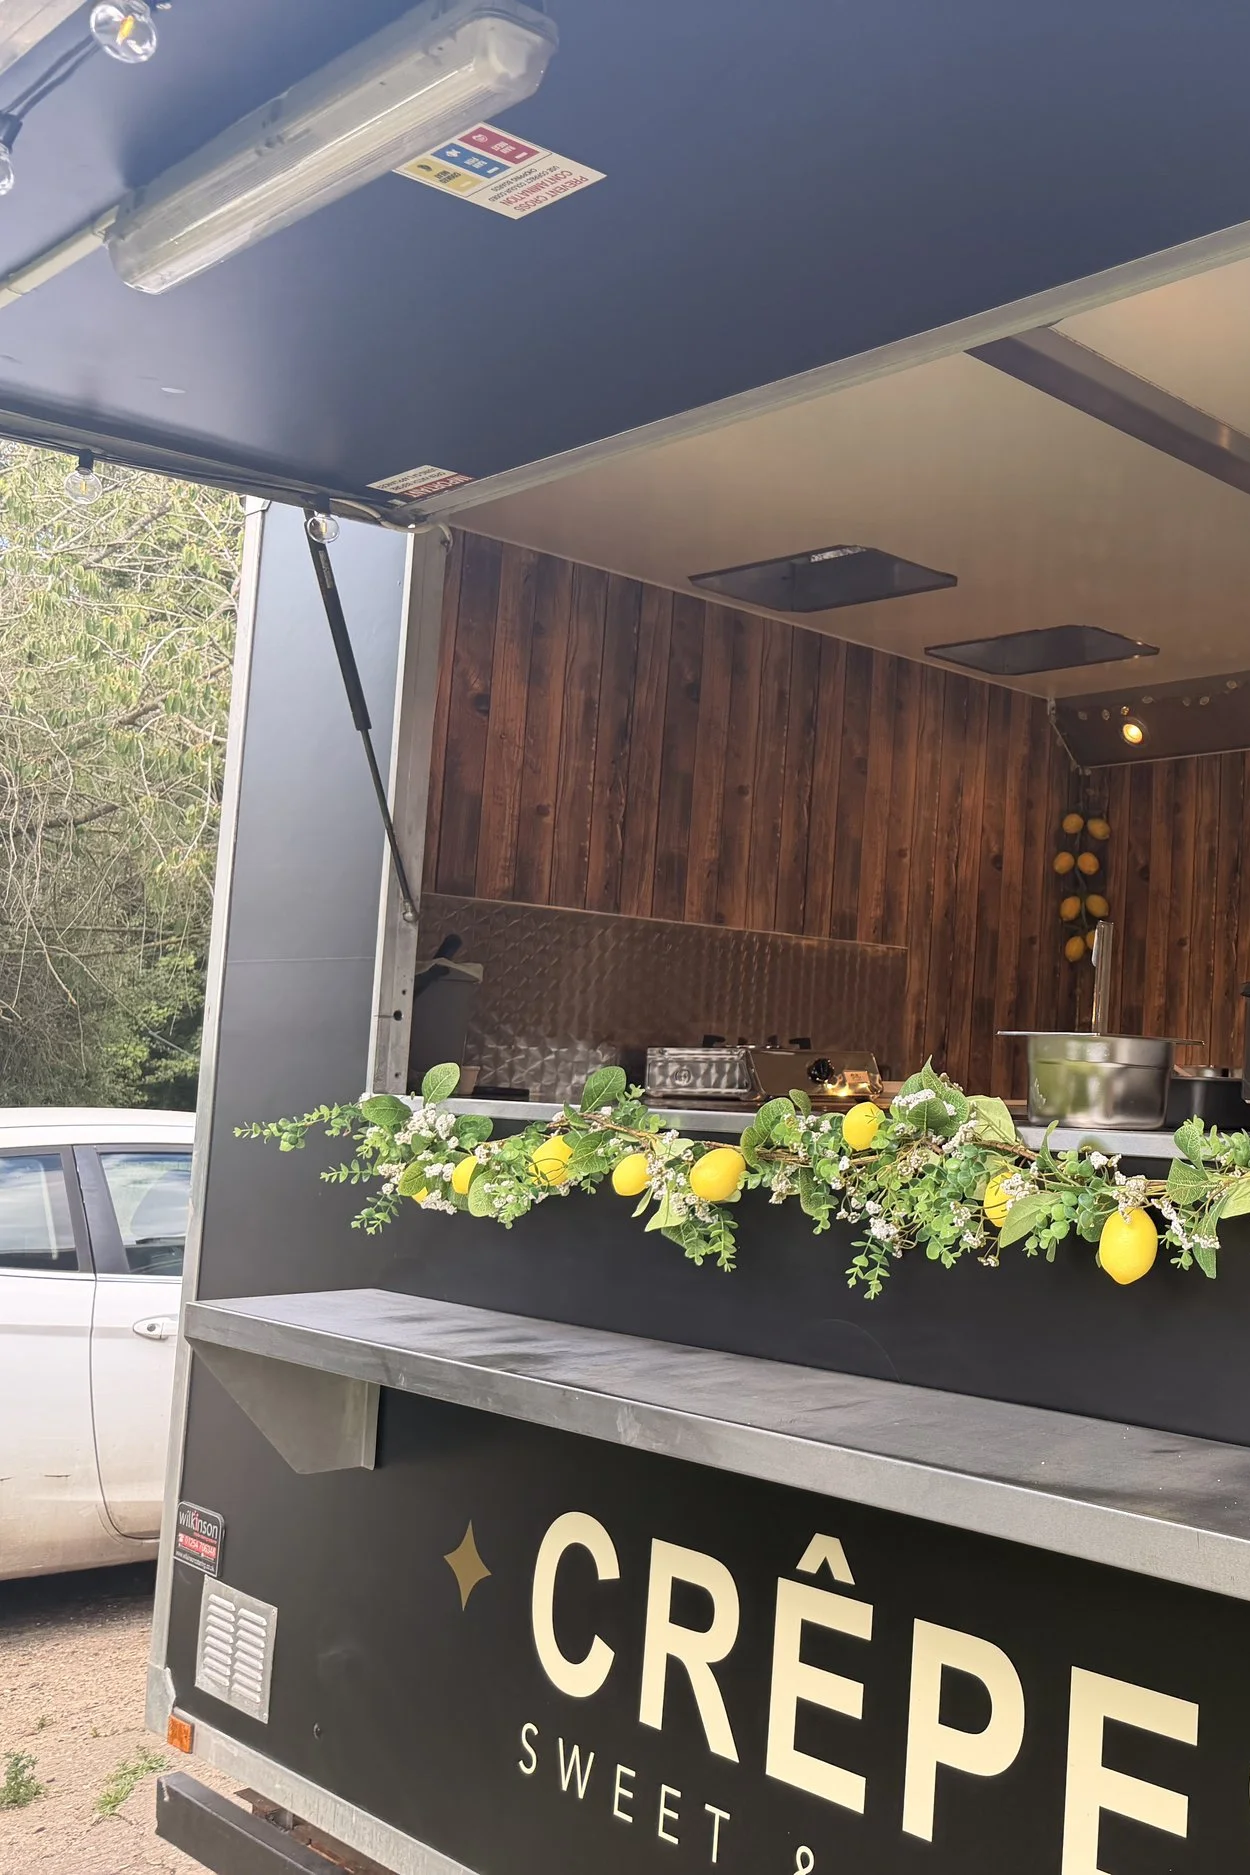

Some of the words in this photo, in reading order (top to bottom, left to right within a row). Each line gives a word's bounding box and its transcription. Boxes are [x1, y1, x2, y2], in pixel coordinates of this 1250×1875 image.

[500, 170, 573, 206] CONTAMINATION
[545, 175, 589, 199] PREVENT
[513, 194, 547, 213] CROSS
[179, 1510, 219, 1540] wilkinson
[519, 1722, 731, 1864] SWEET
